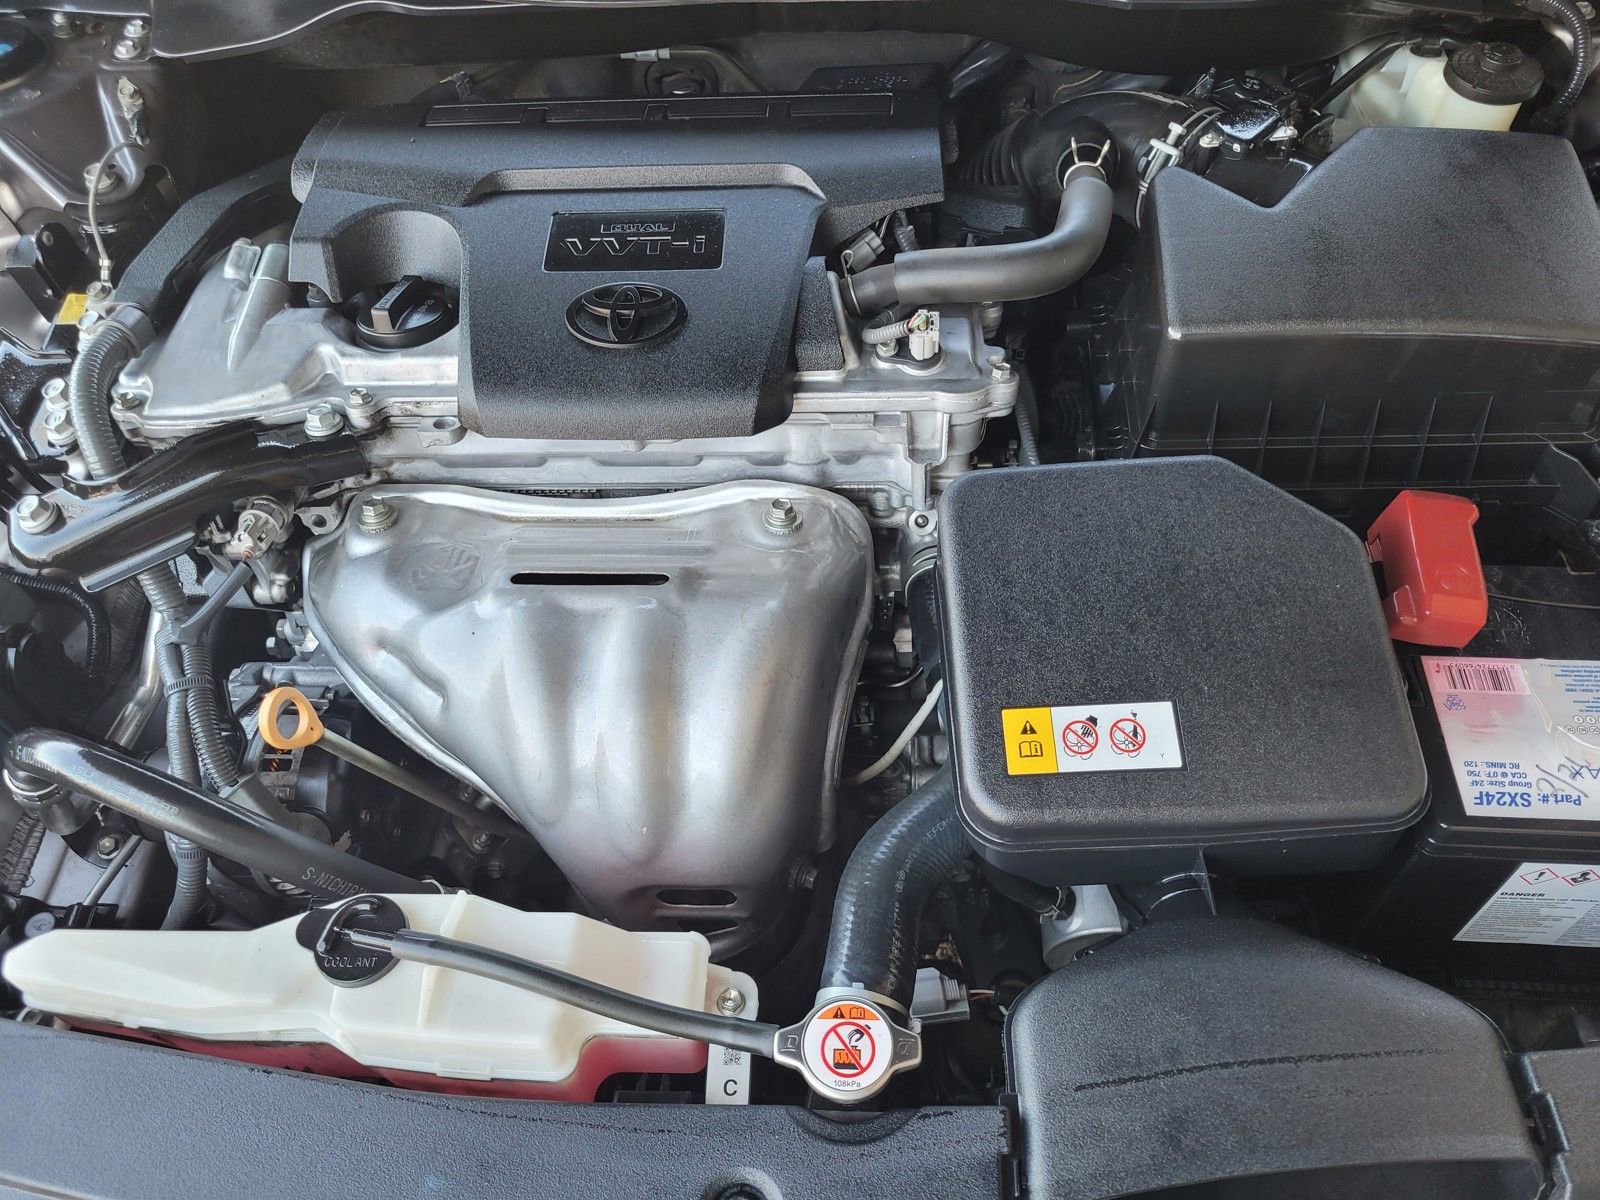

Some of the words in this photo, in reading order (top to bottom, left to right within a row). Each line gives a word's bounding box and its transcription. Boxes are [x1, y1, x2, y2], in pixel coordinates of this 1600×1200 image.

[611, 223, 670, 233] DUAL
[565, 235, 706, 256] VVT-i
[1159, 752, 1165, 760] Y
[1486, 780, 1506, 788] Size:
[1509, 781, 1532, 789] Group
[1474, 791, 1532, 807] SX24F
[1554, 794, 1582, 806] Part
[324, 956, 378, 968] COOLANT
[723, 1079, 738, 1097] C
[833, 1079, 861, 1088] 108kPa
